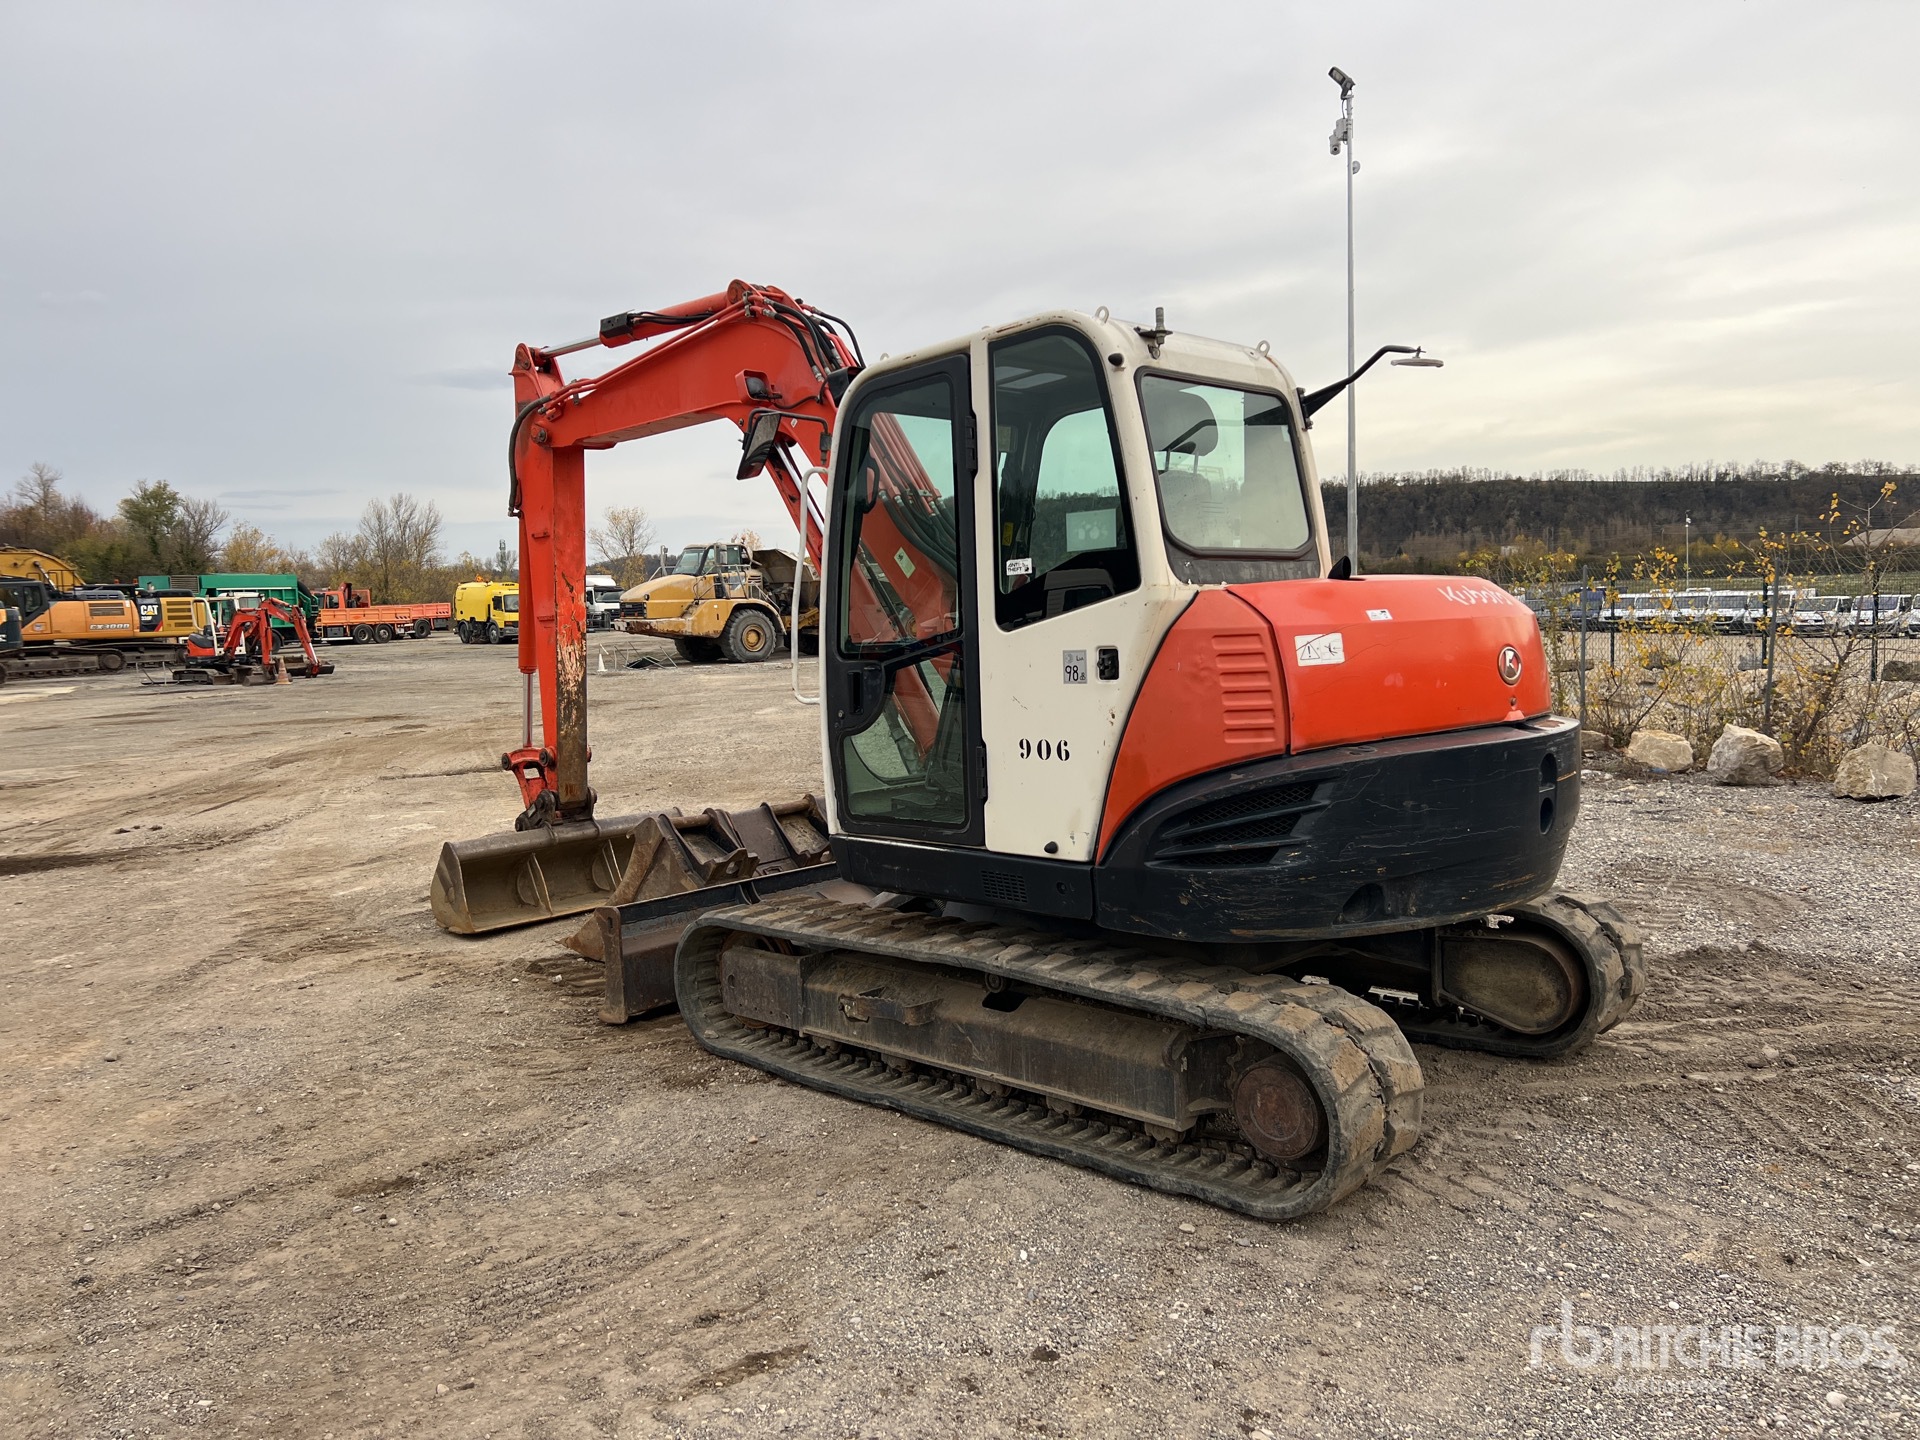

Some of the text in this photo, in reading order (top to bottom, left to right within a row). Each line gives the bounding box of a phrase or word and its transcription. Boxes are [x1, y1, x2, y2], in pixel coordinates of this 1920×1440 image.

[140, 604, 158, 616] CAT
[1065, 665, 1079, 682] 98
[1019, 738, 1070, 761] 906
